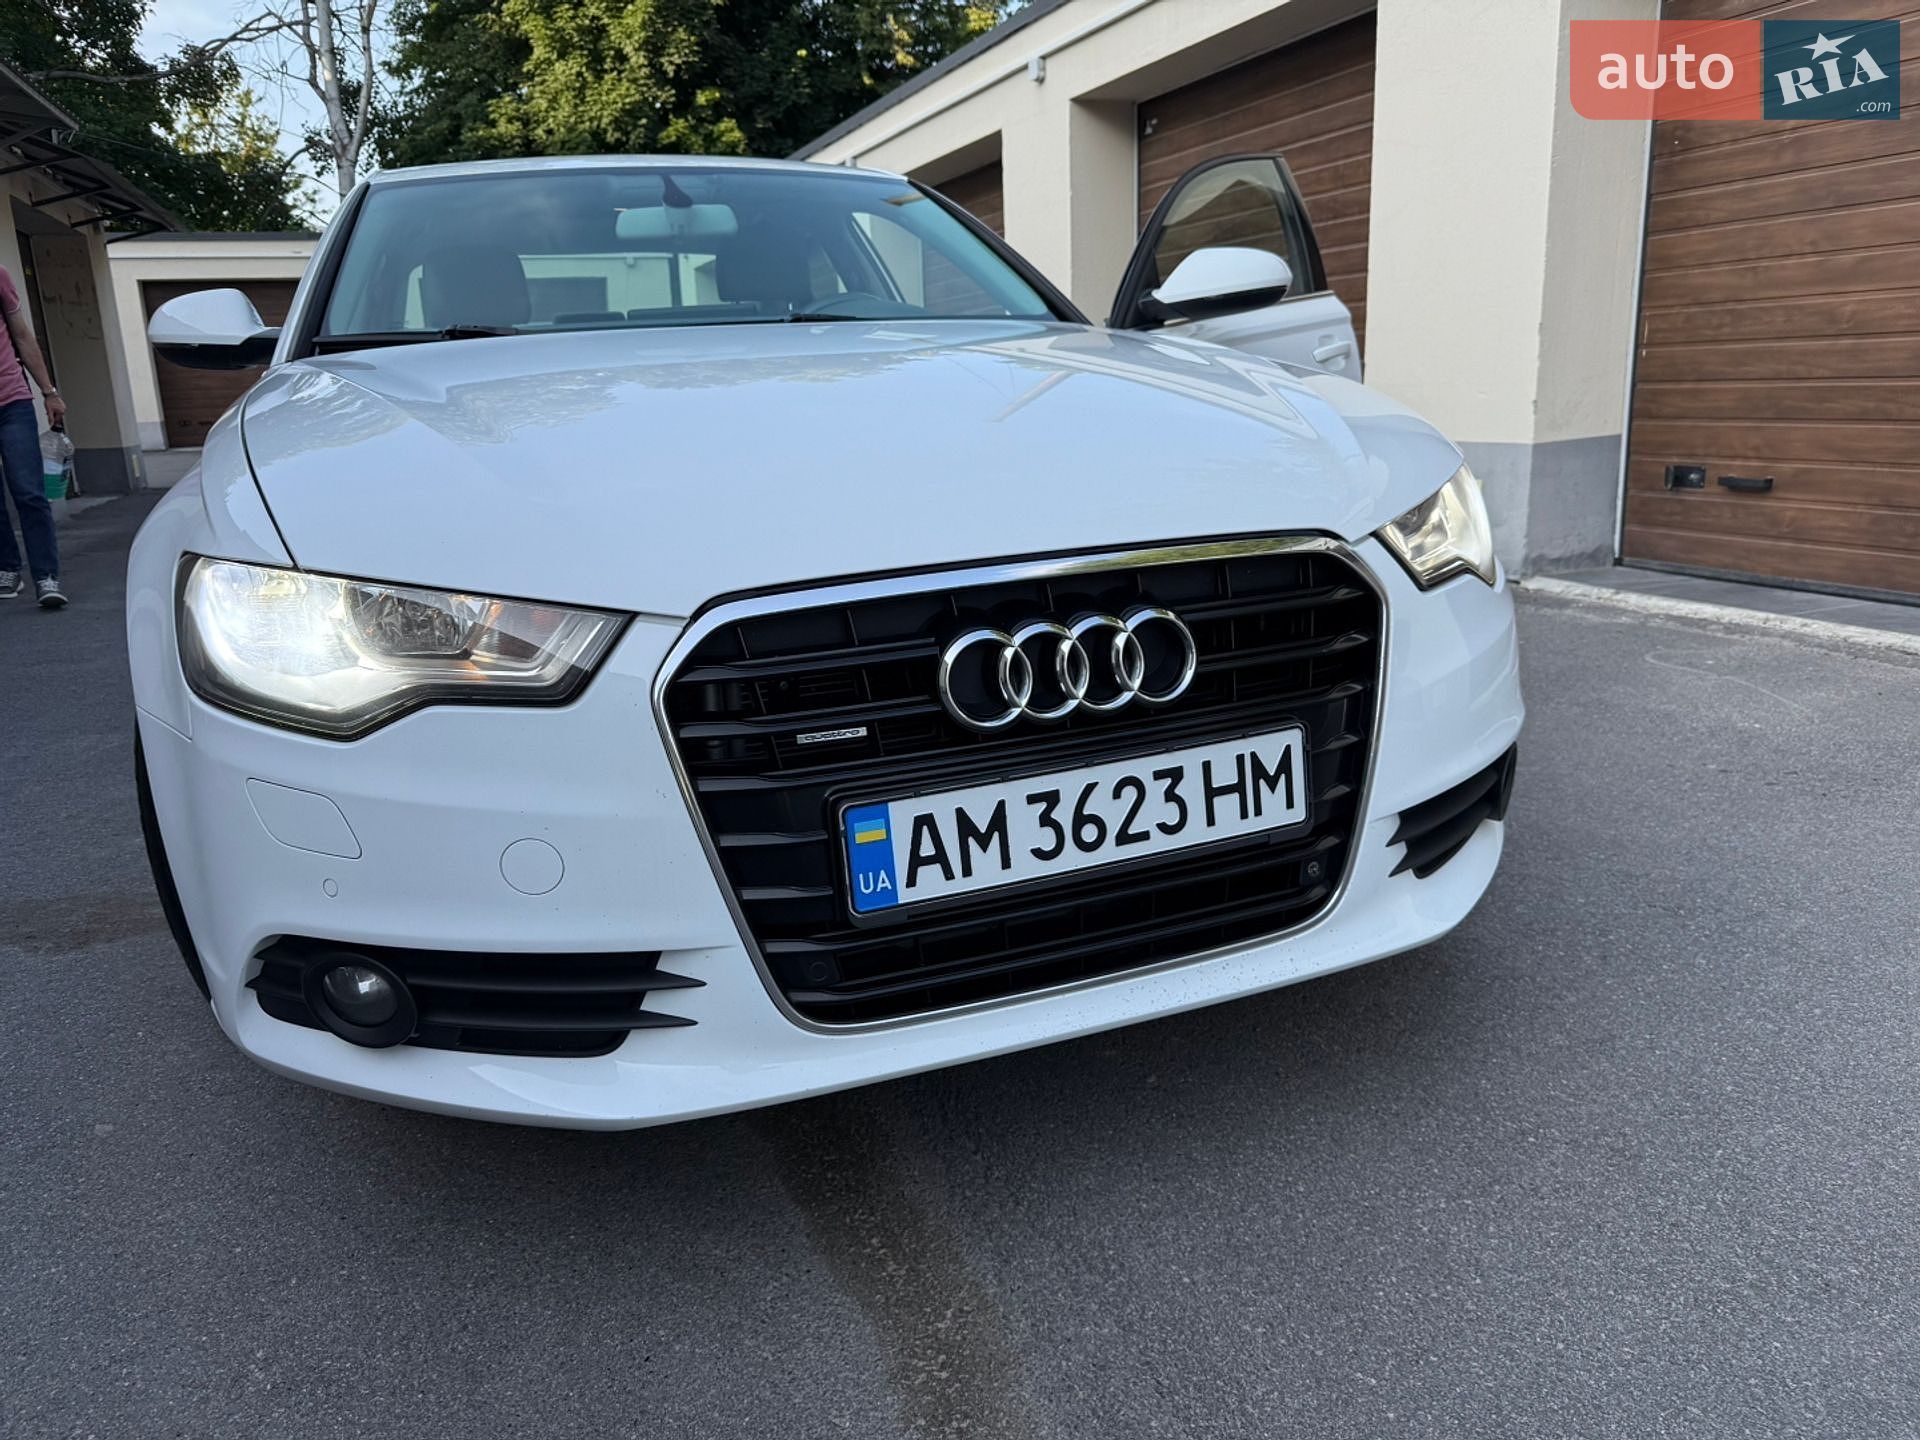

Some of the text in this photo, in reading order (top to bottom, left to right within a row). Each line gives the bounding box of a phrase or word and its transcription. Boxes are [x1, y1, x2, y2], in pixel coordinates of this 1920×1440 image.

[905, 743, 1295, 888] AM 3623 HM
[858, 870, 892, 895] UA
